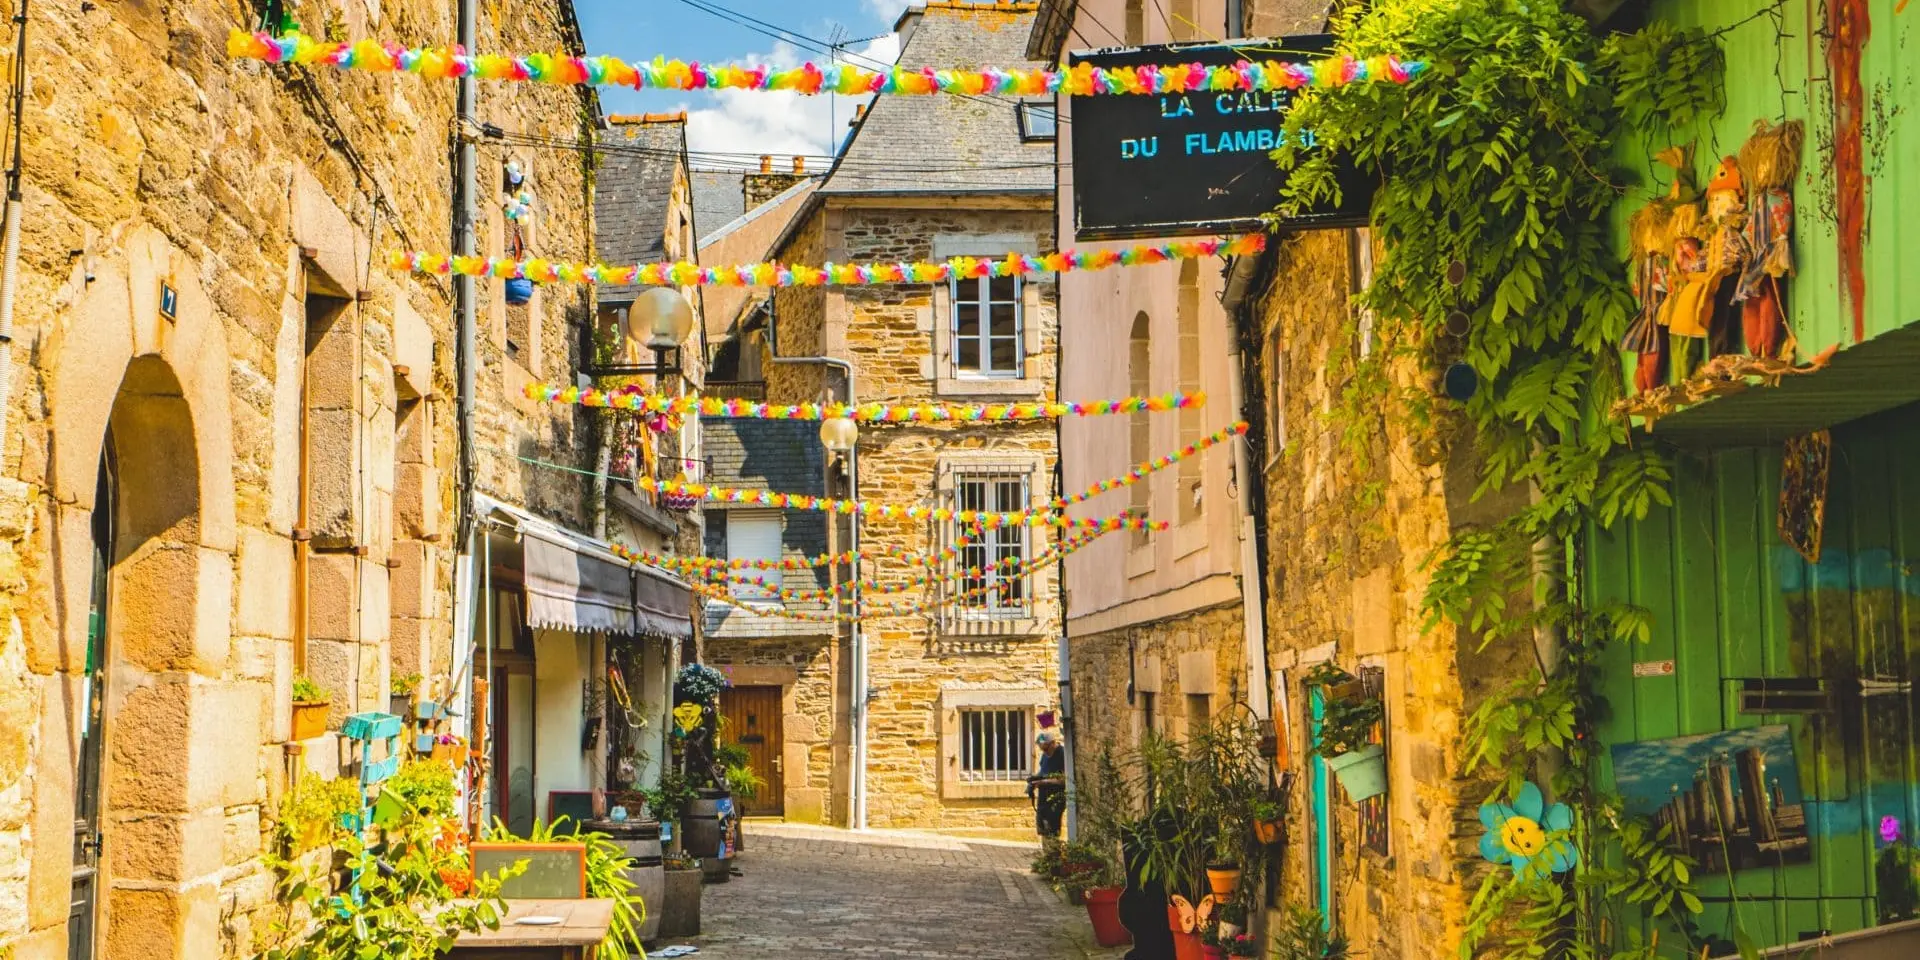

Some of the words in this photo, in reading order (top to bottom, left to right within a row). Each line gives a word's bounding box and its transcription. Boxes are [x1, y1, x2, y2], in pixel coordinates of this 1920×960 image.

[1161, 96, 1194, 117] LA
[1215, 90, 1288, 114] CALE
[1121, 136, 1158, 159] DU
